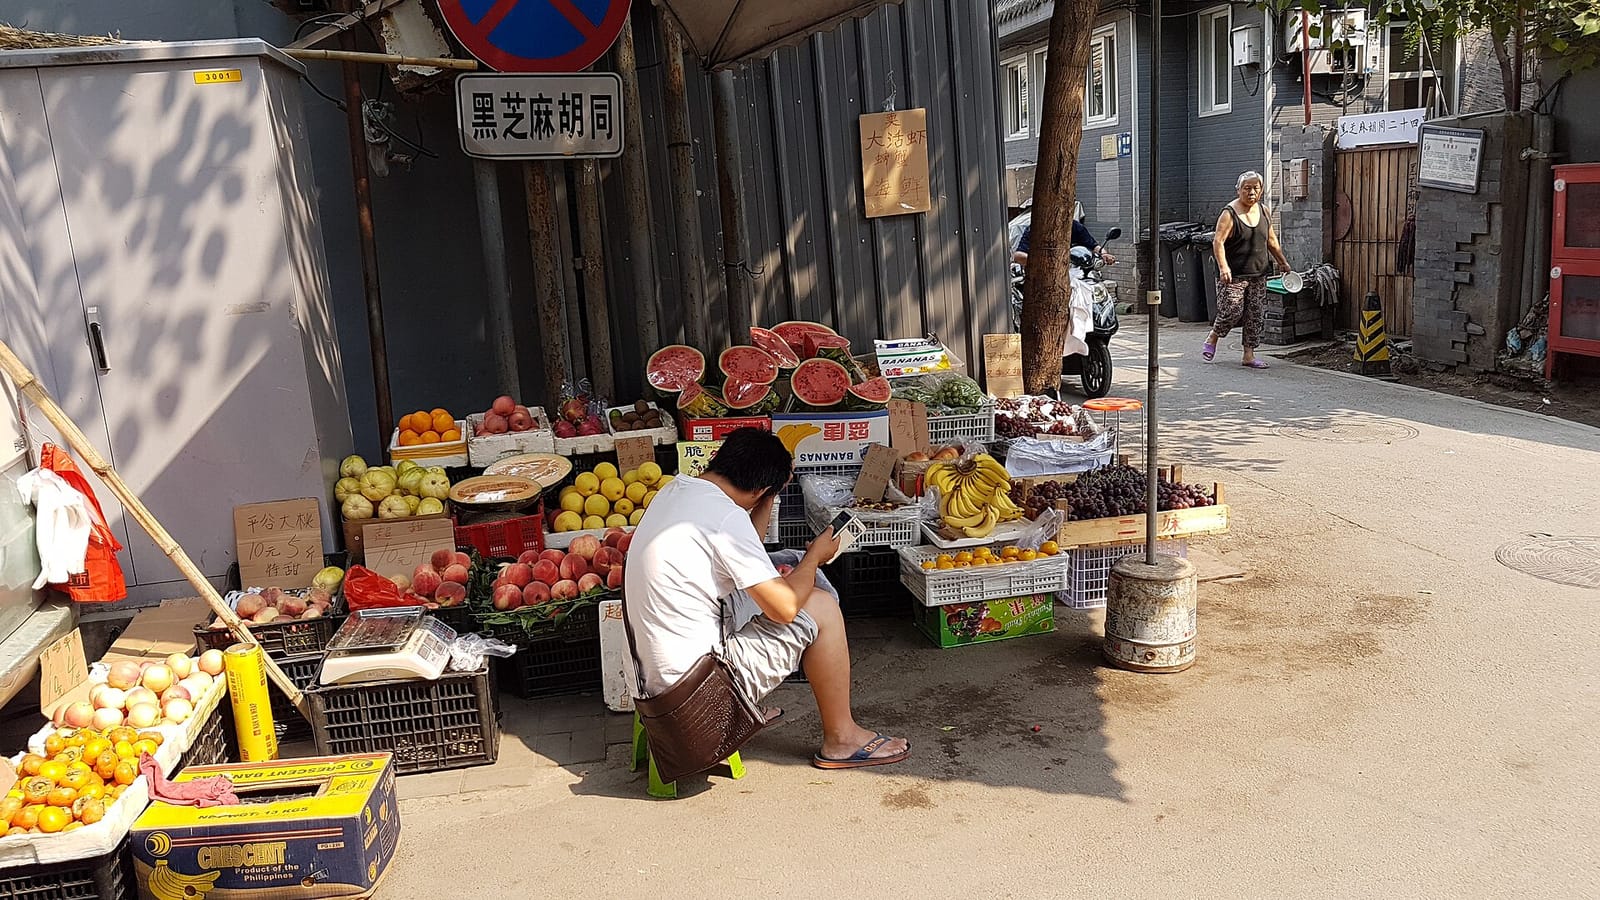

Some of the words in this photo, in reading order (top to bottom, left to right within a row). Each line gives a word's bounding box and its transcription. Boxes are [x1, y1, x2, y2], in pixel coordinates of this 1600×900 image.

[205, 72, 230, 81] 3001
[472, 91, 613, 140] 黑芝麻胡同
[1340, 116, 1425, 137] 黑芝麻胡同二十四
[865, 129, 926, 151] 大活虾
[881, 354, 937, 365] BANANAS
[800, 451, 854, 462] BANANAS
[247, 512, 316, 533] 平谷大桃
[267, 764, 347, 777] CRESCENT
[197, 841, 287, 870] CRESCENT
[235, 867, 270, 875] Product
[284, 863, 300, 871] the
[243, 872, 294, 883] Philippines
